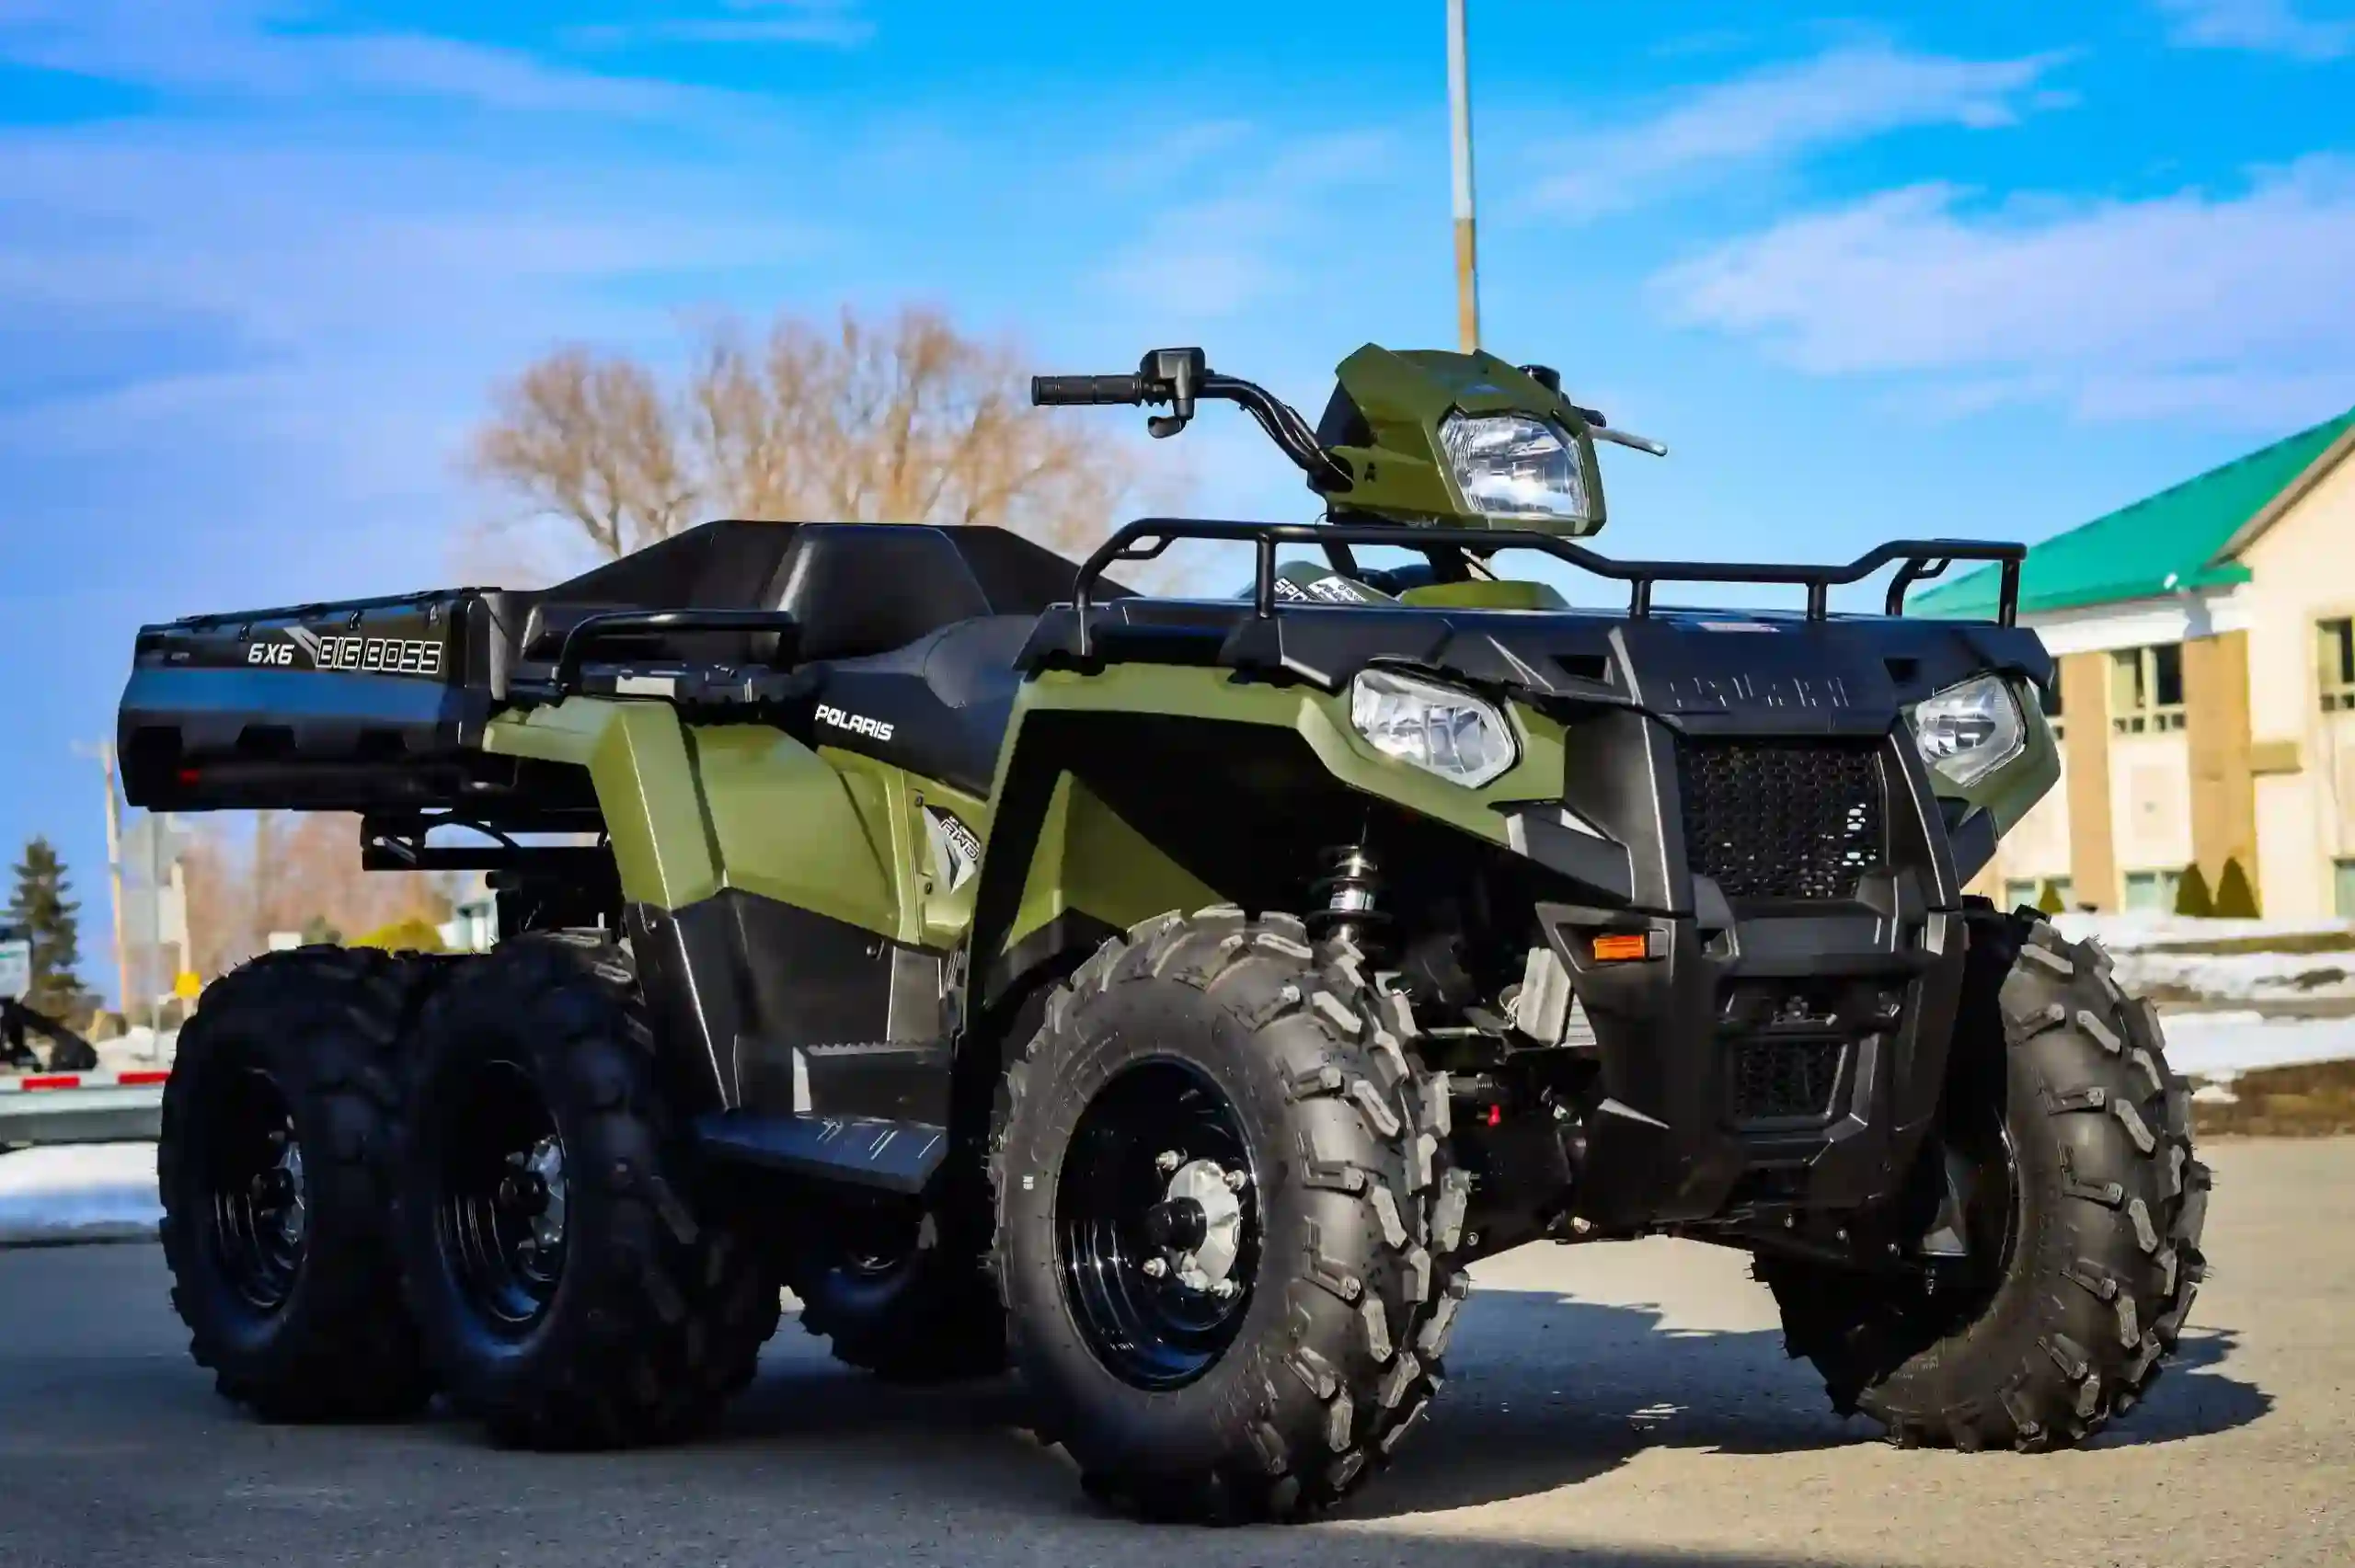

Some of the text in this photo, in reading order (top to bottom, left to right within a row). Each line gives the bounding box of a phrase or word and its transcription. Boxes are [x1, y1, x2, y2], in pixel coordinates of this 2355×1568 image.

[247, 636, 443, 674] 6X6 BIG BOSS
[814, 704, 895, 742] POLARIS
[938, 818, 980, 862] AWD
